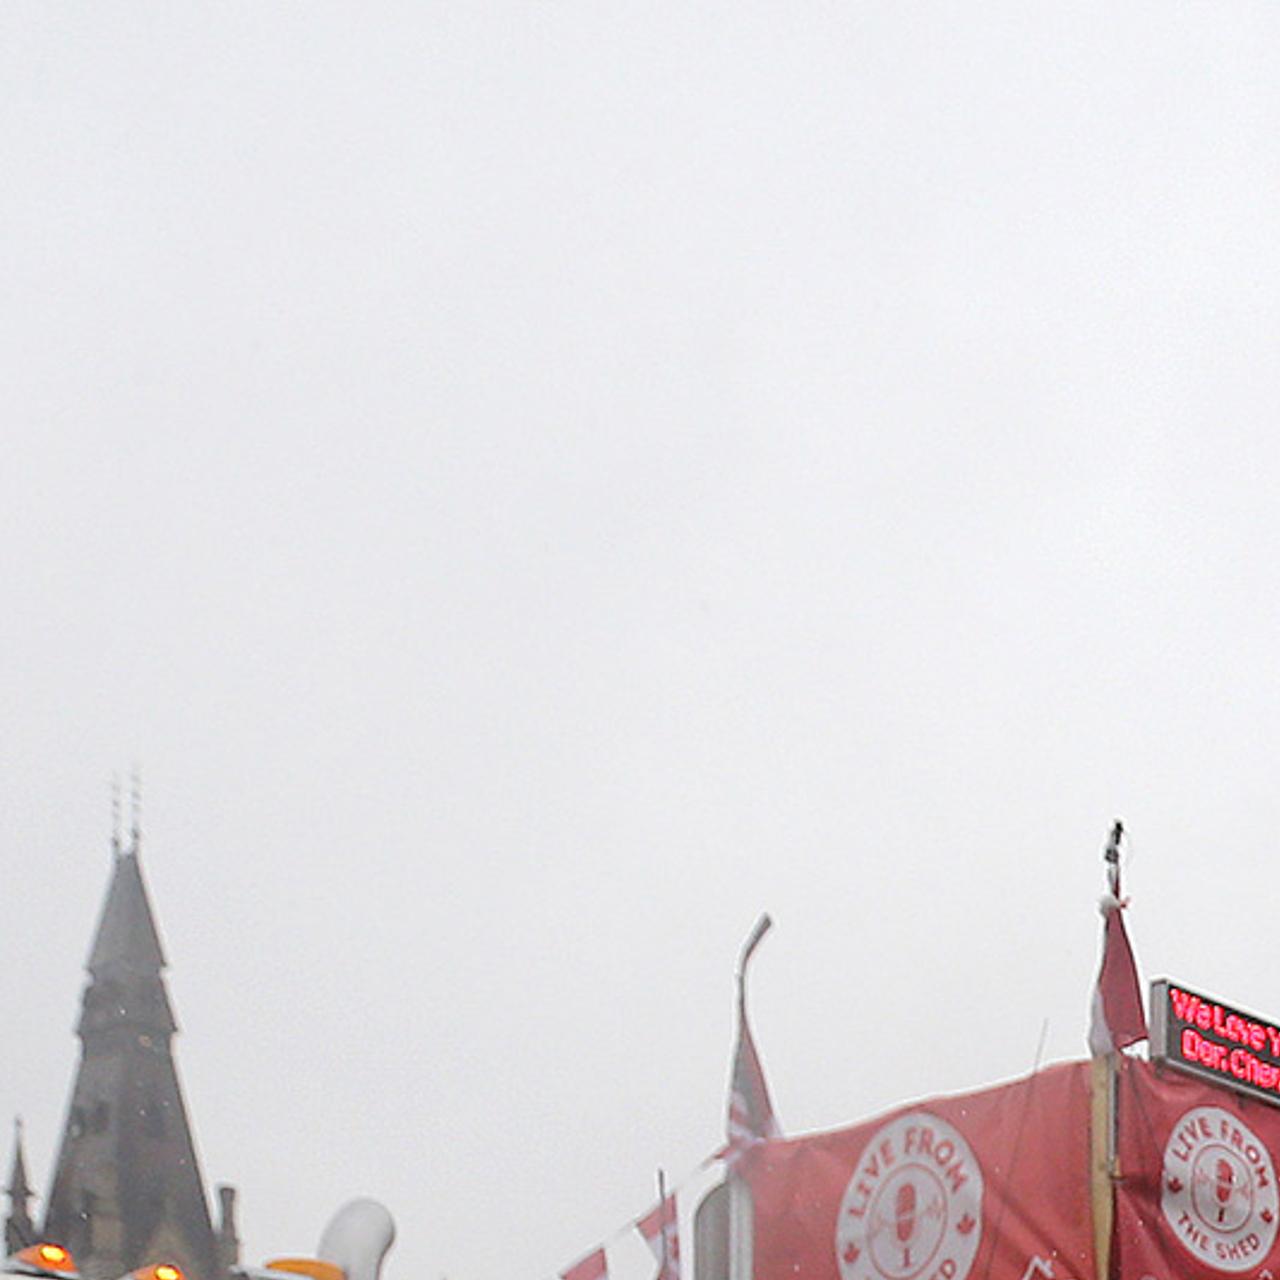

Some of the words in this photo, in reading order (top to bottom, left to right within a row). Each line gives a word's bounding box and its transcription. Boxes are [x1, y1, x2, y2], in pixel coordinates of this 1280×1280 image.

[1169, 988, 1214, 1030] We
[1213, 1005, 1266, 1051] Love
[850, 1138, 895, 1218] LIVE
[903, 1125, 971, 1195] FROM
[1172, 1116, 1213, 1163] LIVE
[1219, 1118, 1270, 1190] FROM
[1178, 1209, 1211, 1252] THE
[1215, 1231, 1262, 1261] SHED
